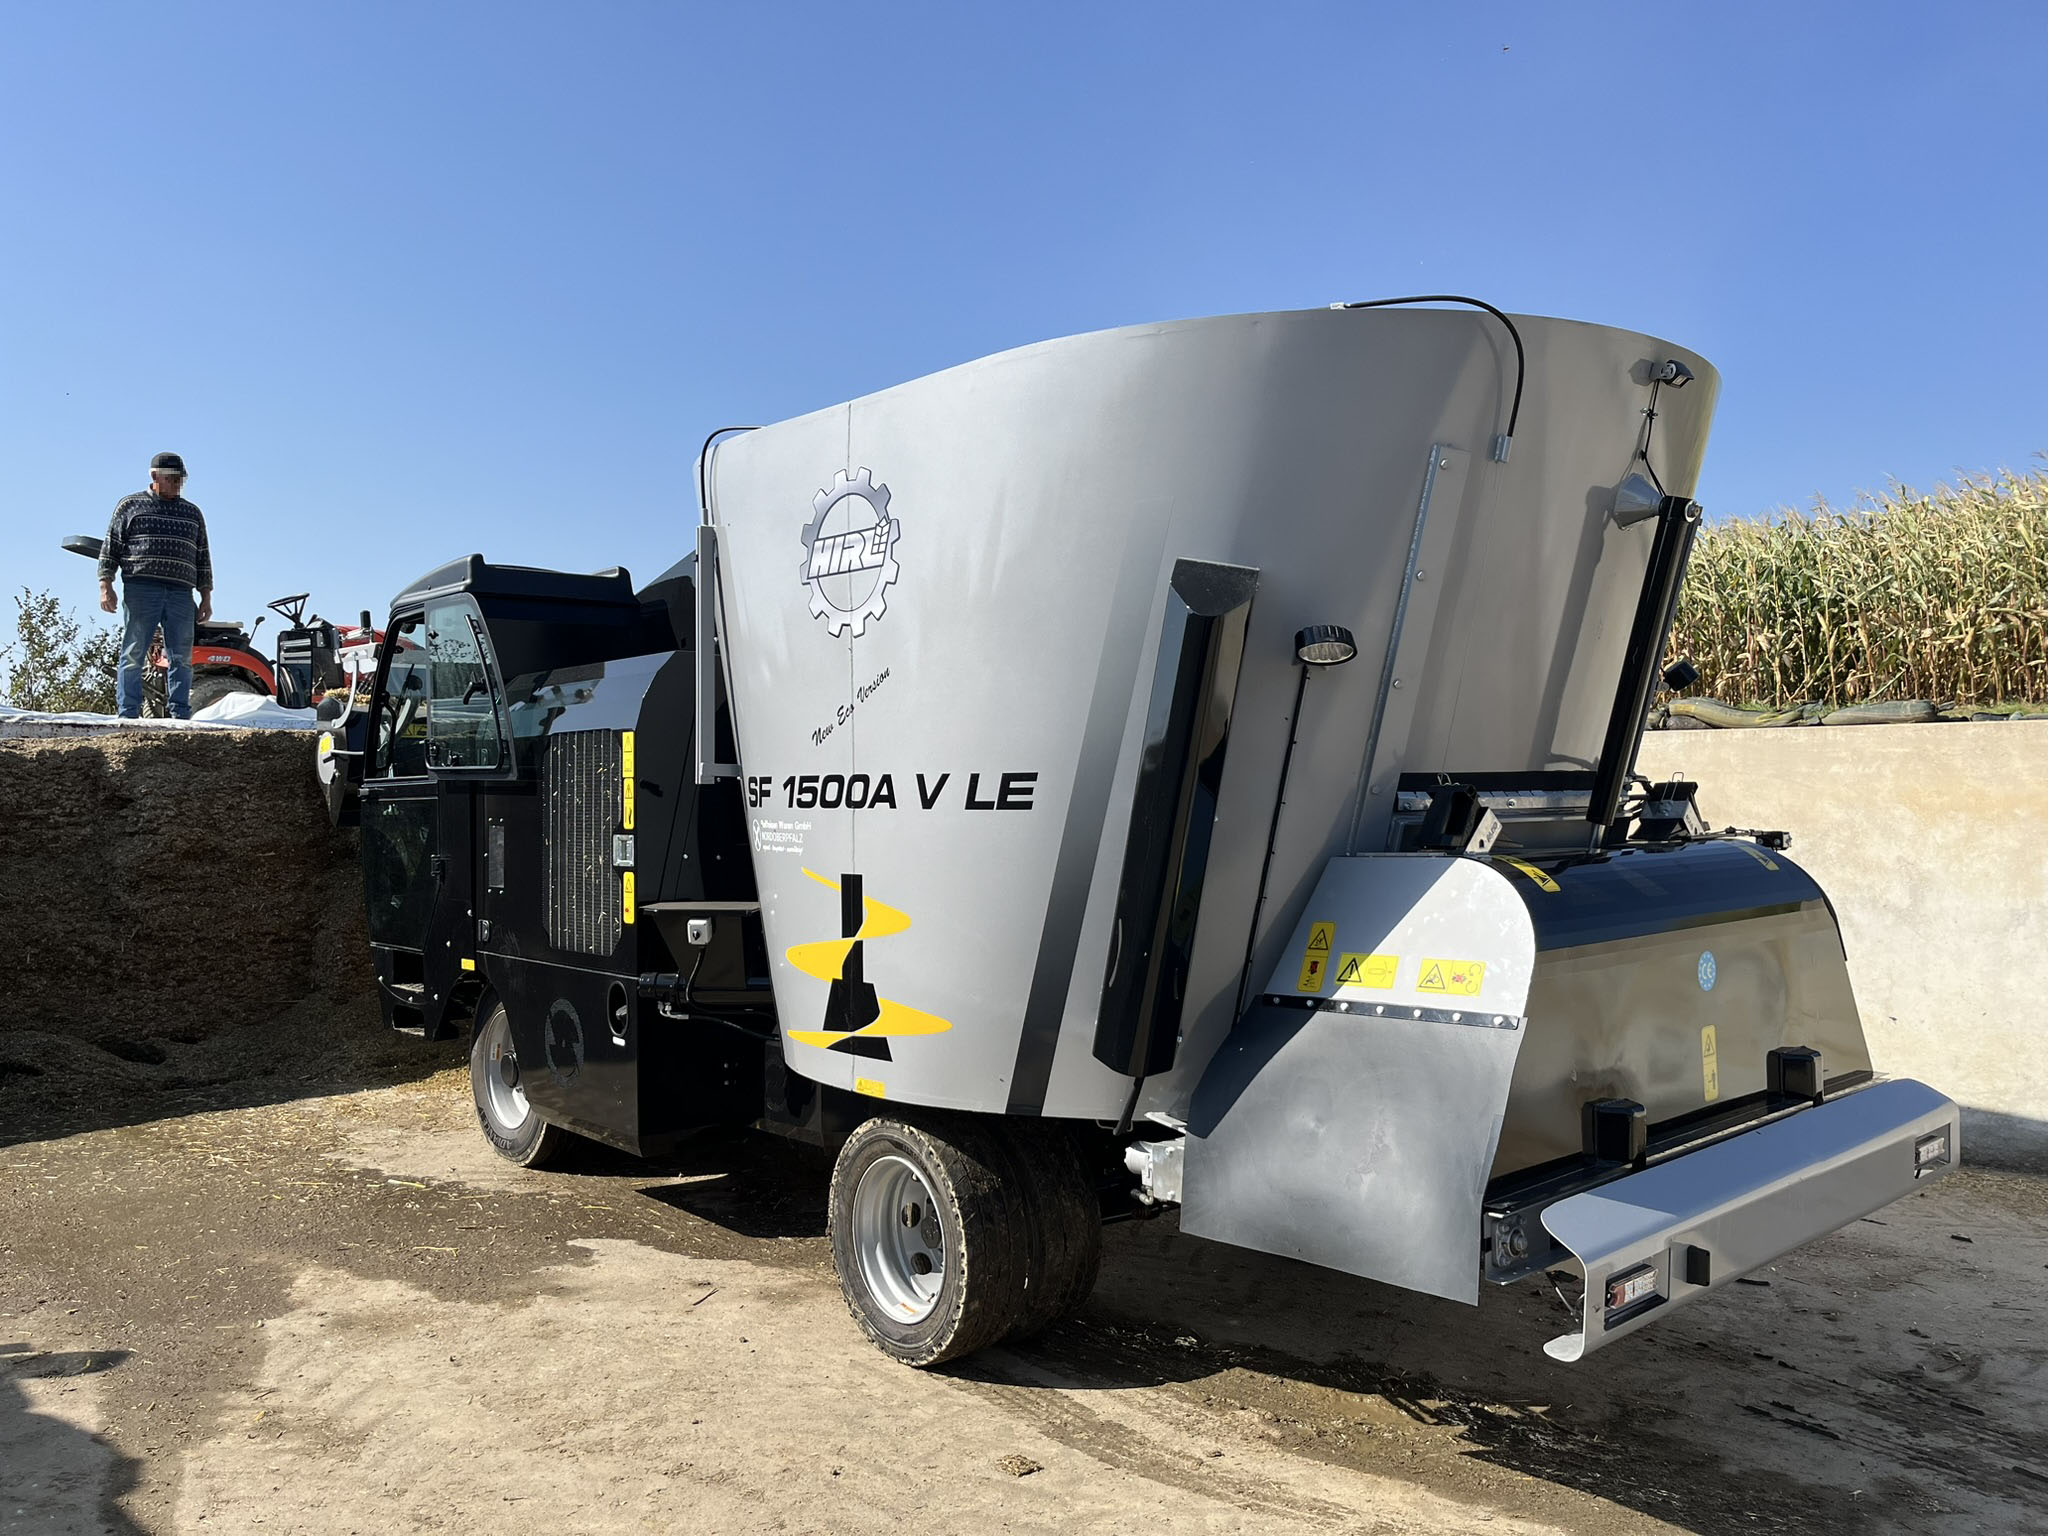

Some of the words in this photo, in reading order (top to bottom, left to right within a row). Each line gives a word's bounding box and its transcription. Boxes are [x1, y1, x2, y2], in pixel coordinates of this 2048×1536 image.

[812, 724, 834, 746] New
[837, 703, 854, 726] Eco
[857, 667, 890, 703] Version
[748, 776, 772, 808] SF
[783, 773, 897, 809] 1500A
[916, 773, 951, 810] V
[965, 772, 1039, 811] LE
